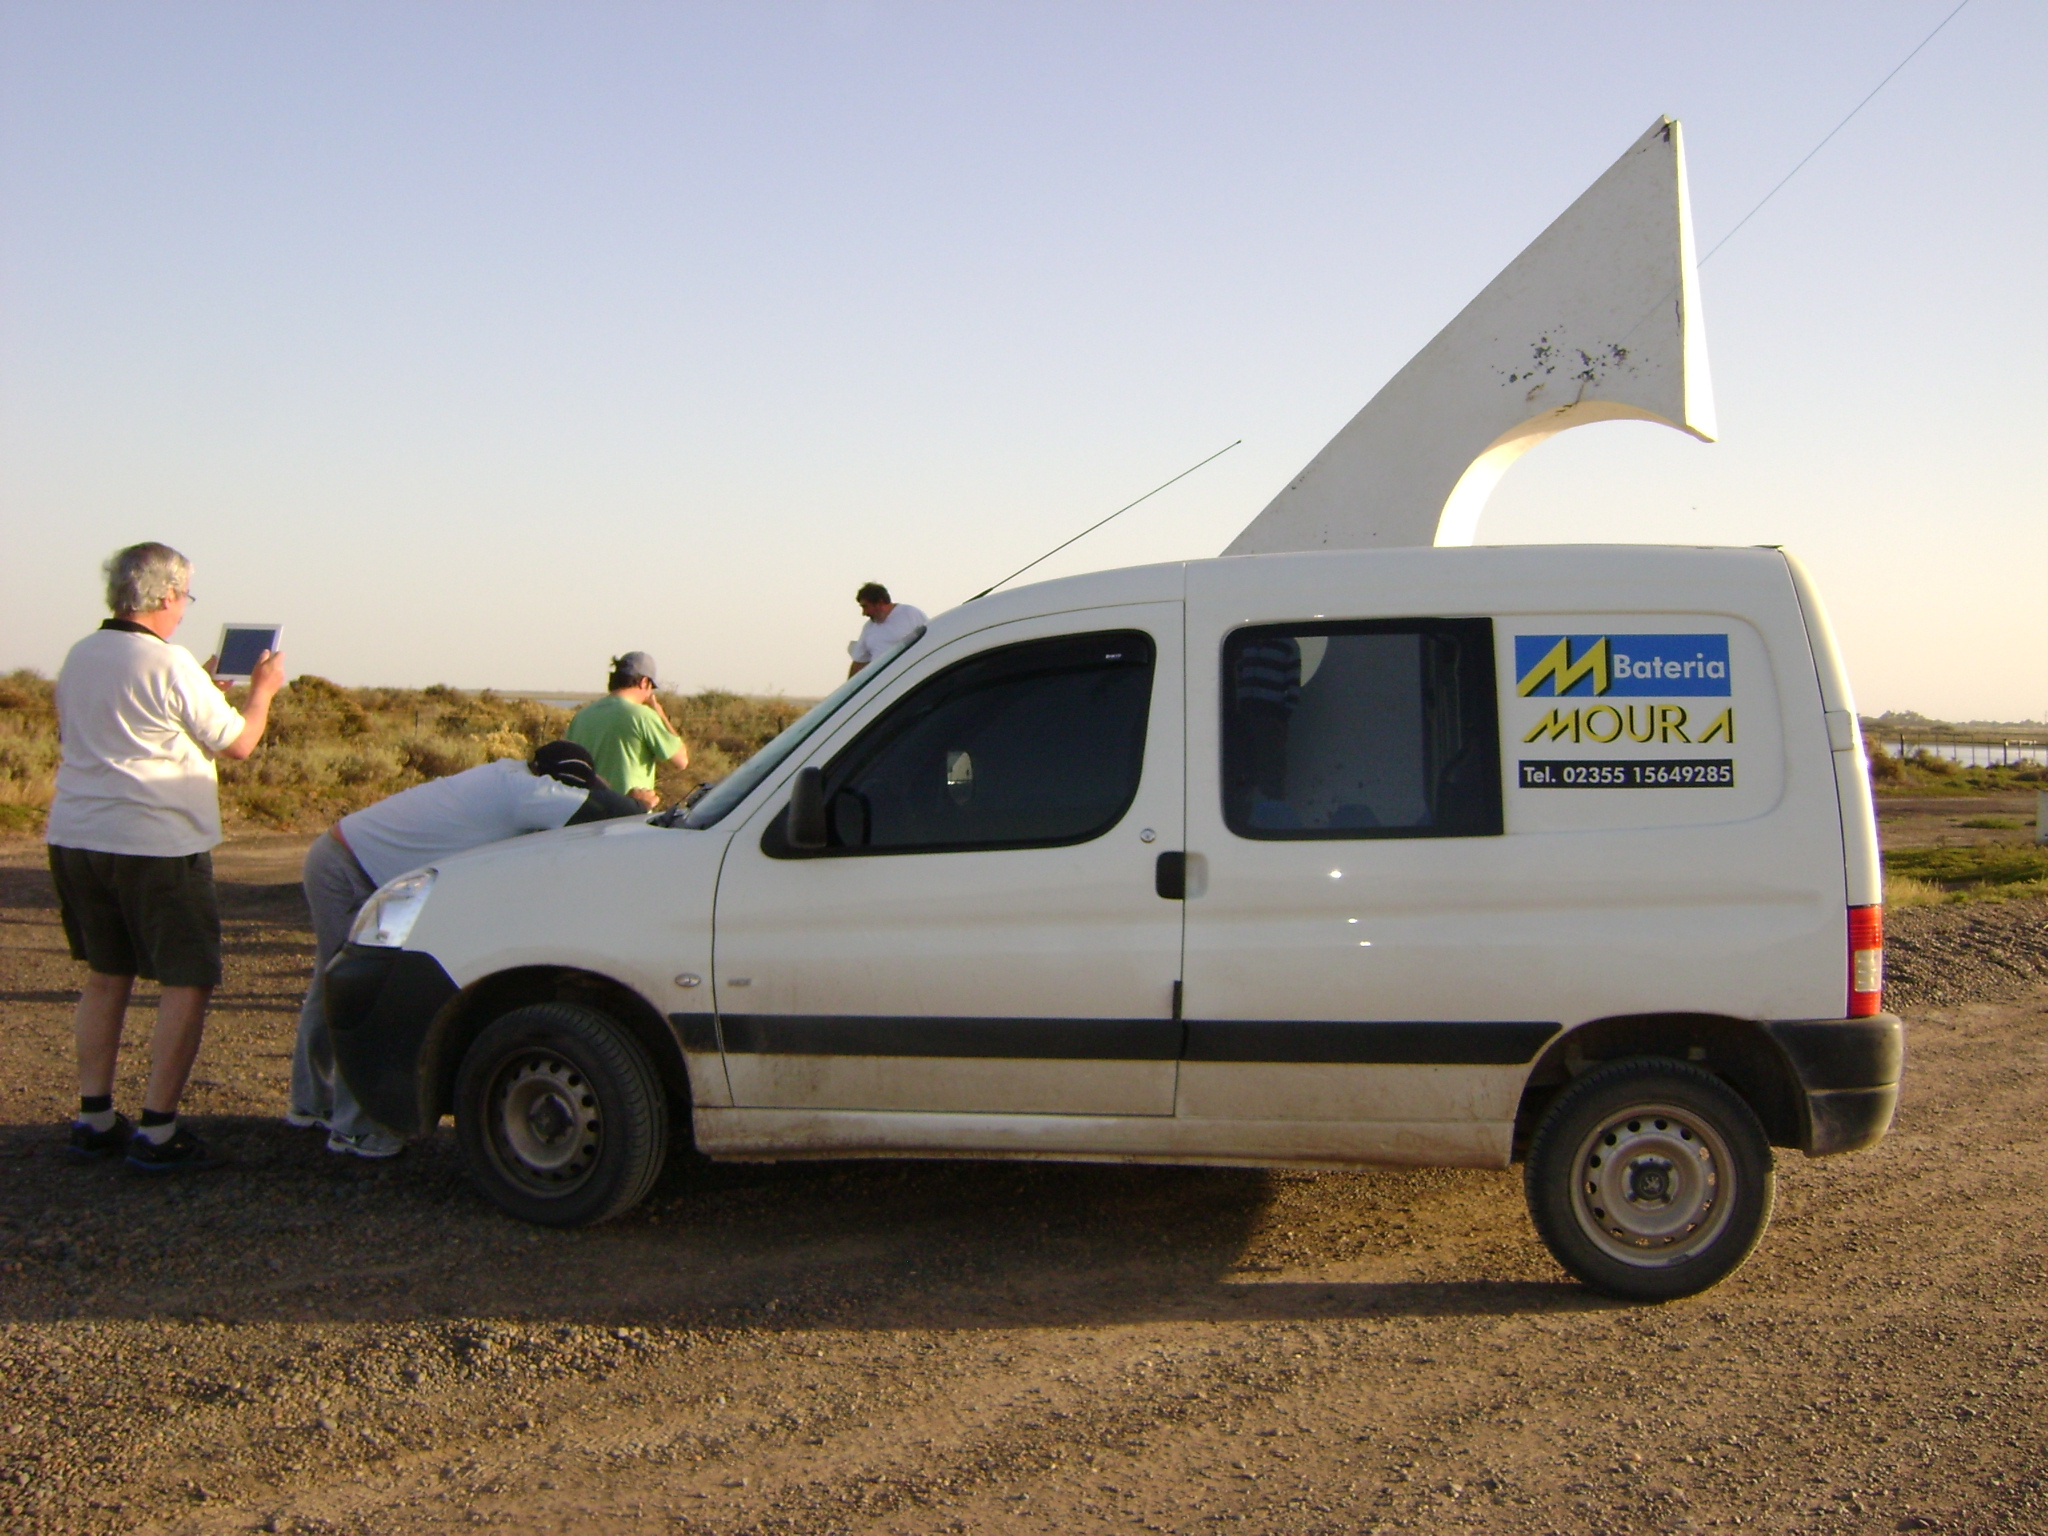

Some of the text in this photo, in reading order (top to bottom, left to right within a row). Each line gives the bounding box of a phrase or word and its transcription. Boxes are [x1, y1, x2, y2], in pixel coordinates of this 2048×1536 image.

[1613, 653, 1725, 679] Bateria
[1521, 704, 1734, 744] MOURA
[1523, 765, 1731, 783] Tel. 02355 15649285
